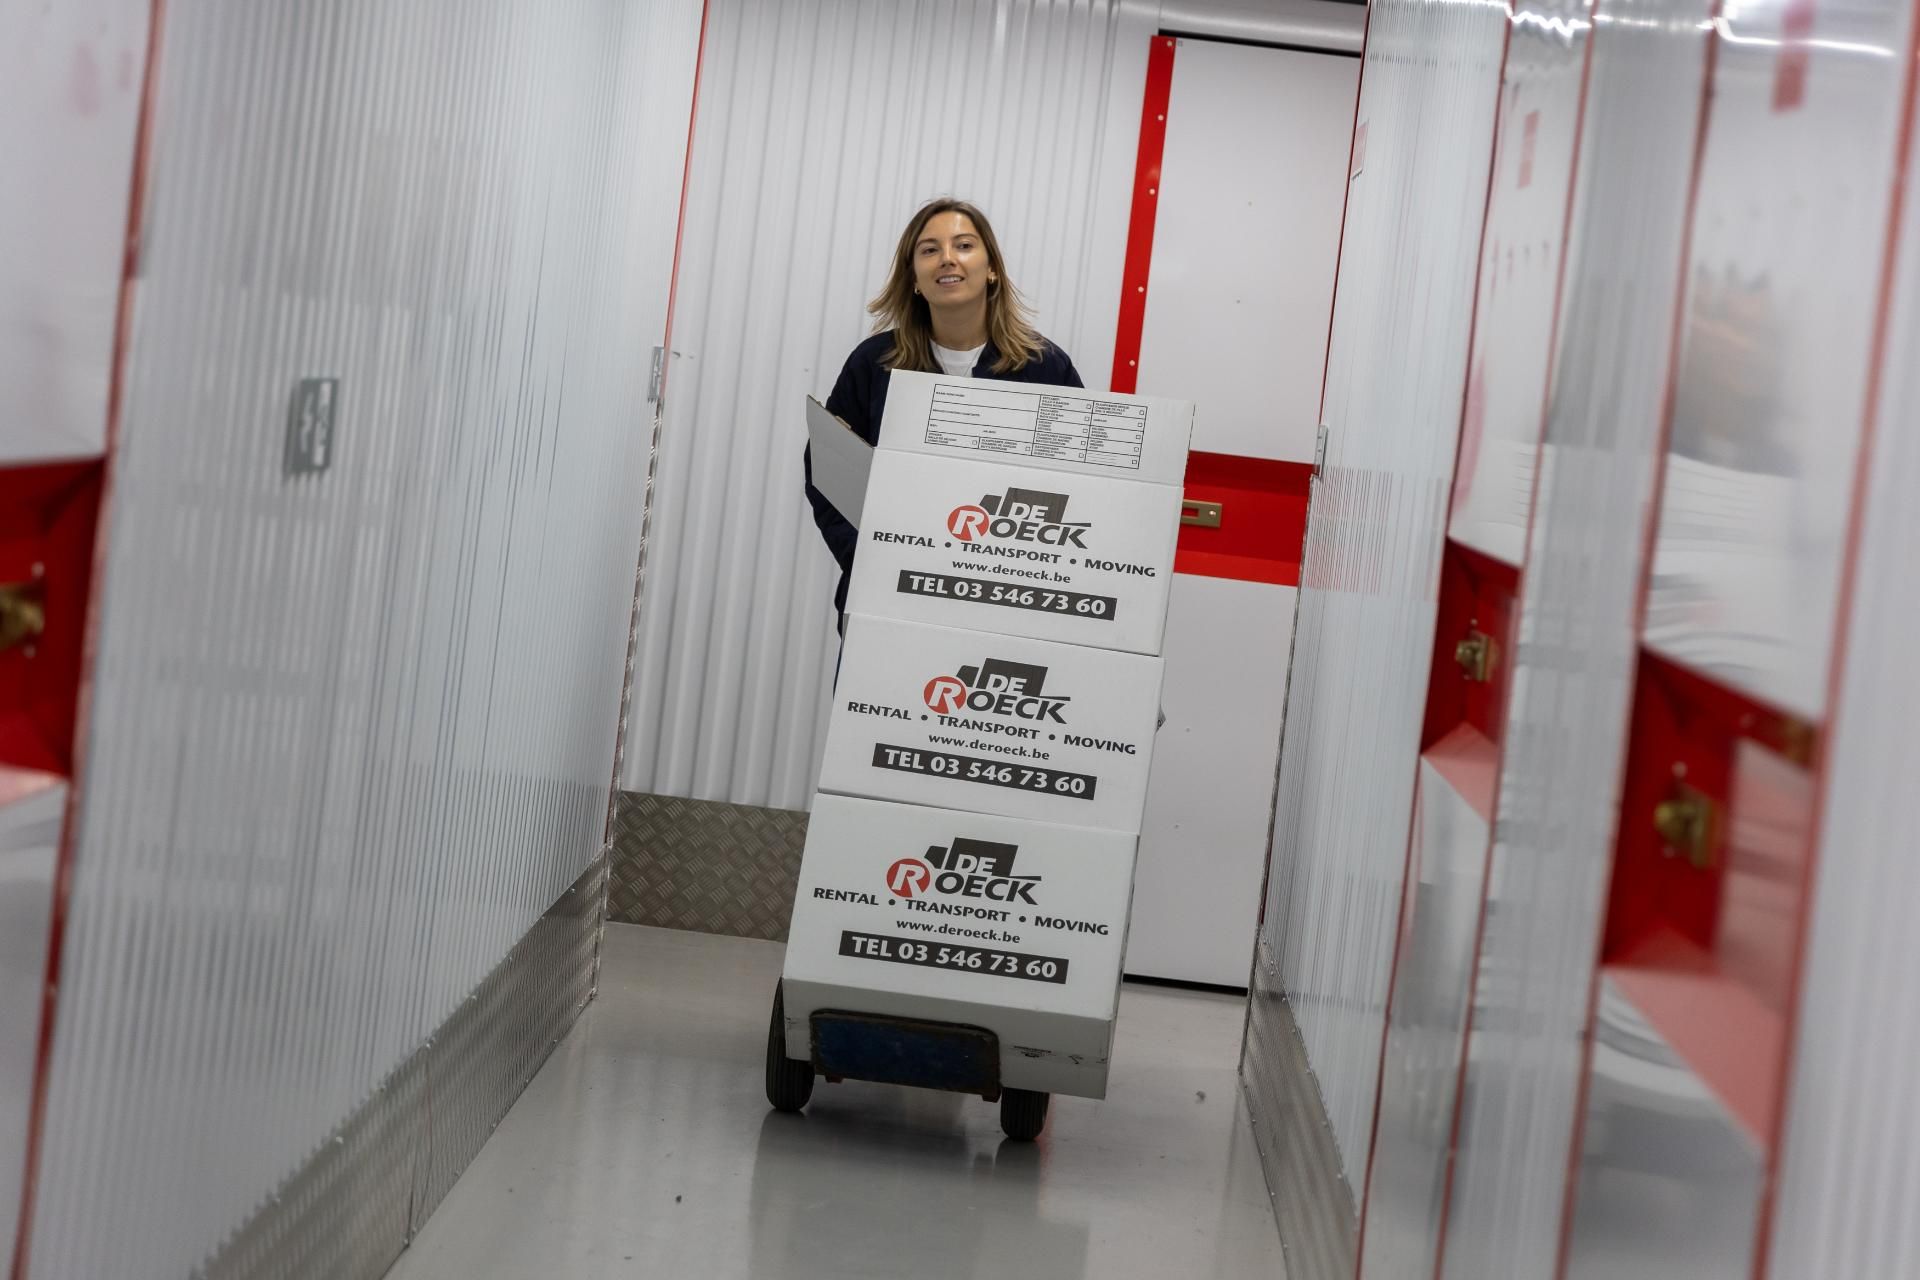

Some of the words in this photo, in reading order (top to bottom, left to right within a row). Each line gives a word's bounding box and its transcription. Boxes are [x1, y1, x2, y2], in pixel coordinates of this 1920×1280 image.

[952, 510, 1089, 549] ROECK
[1009, 502, 1047, 522] DE
[872, 531, 936, 548] RENTAL
[961, 542, 1062, 564] TRANSPORT
[1084, 558, 1156, 578] MOVING
[952, 560, 1072, 584] www.deroeck.be
[910, 575, 948, 595] TEL
[954, 581, 983, 599] 03
[990, 586, 1034, 606] 546
[1041, 593, 1069, 610] 73
[1075, 599, 1106, 615] 60
[929, 682, 1069, 724] ROECK
[987, 674, 1026, 695] DE
[847, 701, 912, 721] RENTAL
[937, 714, 1041, 740] TRANSPORT
[1063, 734, 1137, 755] MOVING
[928, 734, 1050, 760] www.deroeck.be
[885, 748, 924, 770] TEL
[930, 756, 960, 776] 03
[967, 762, 1012, 784] 546
[1019, 769, 1048, 790] 73
[1054, 777, 1085, 796] 60
[892, 864, 1039, 905] ROECK
[957, 854, 997, 875] DE
[813, 887, 879, 906] RENTAL
[905, 899, 1011, 922] TRANSPORT
[1034, 916, 1109, 936] MOVING
[896, 920, 1021, 943] www.deroeck.be
[851, 936, 892, 957] TEL
[898, 942, 928, 962] 03
[935, 948, 982, 969] 546
[989, 954, 1019, 973] 73
[1025, 960, 1057, 980] 60
